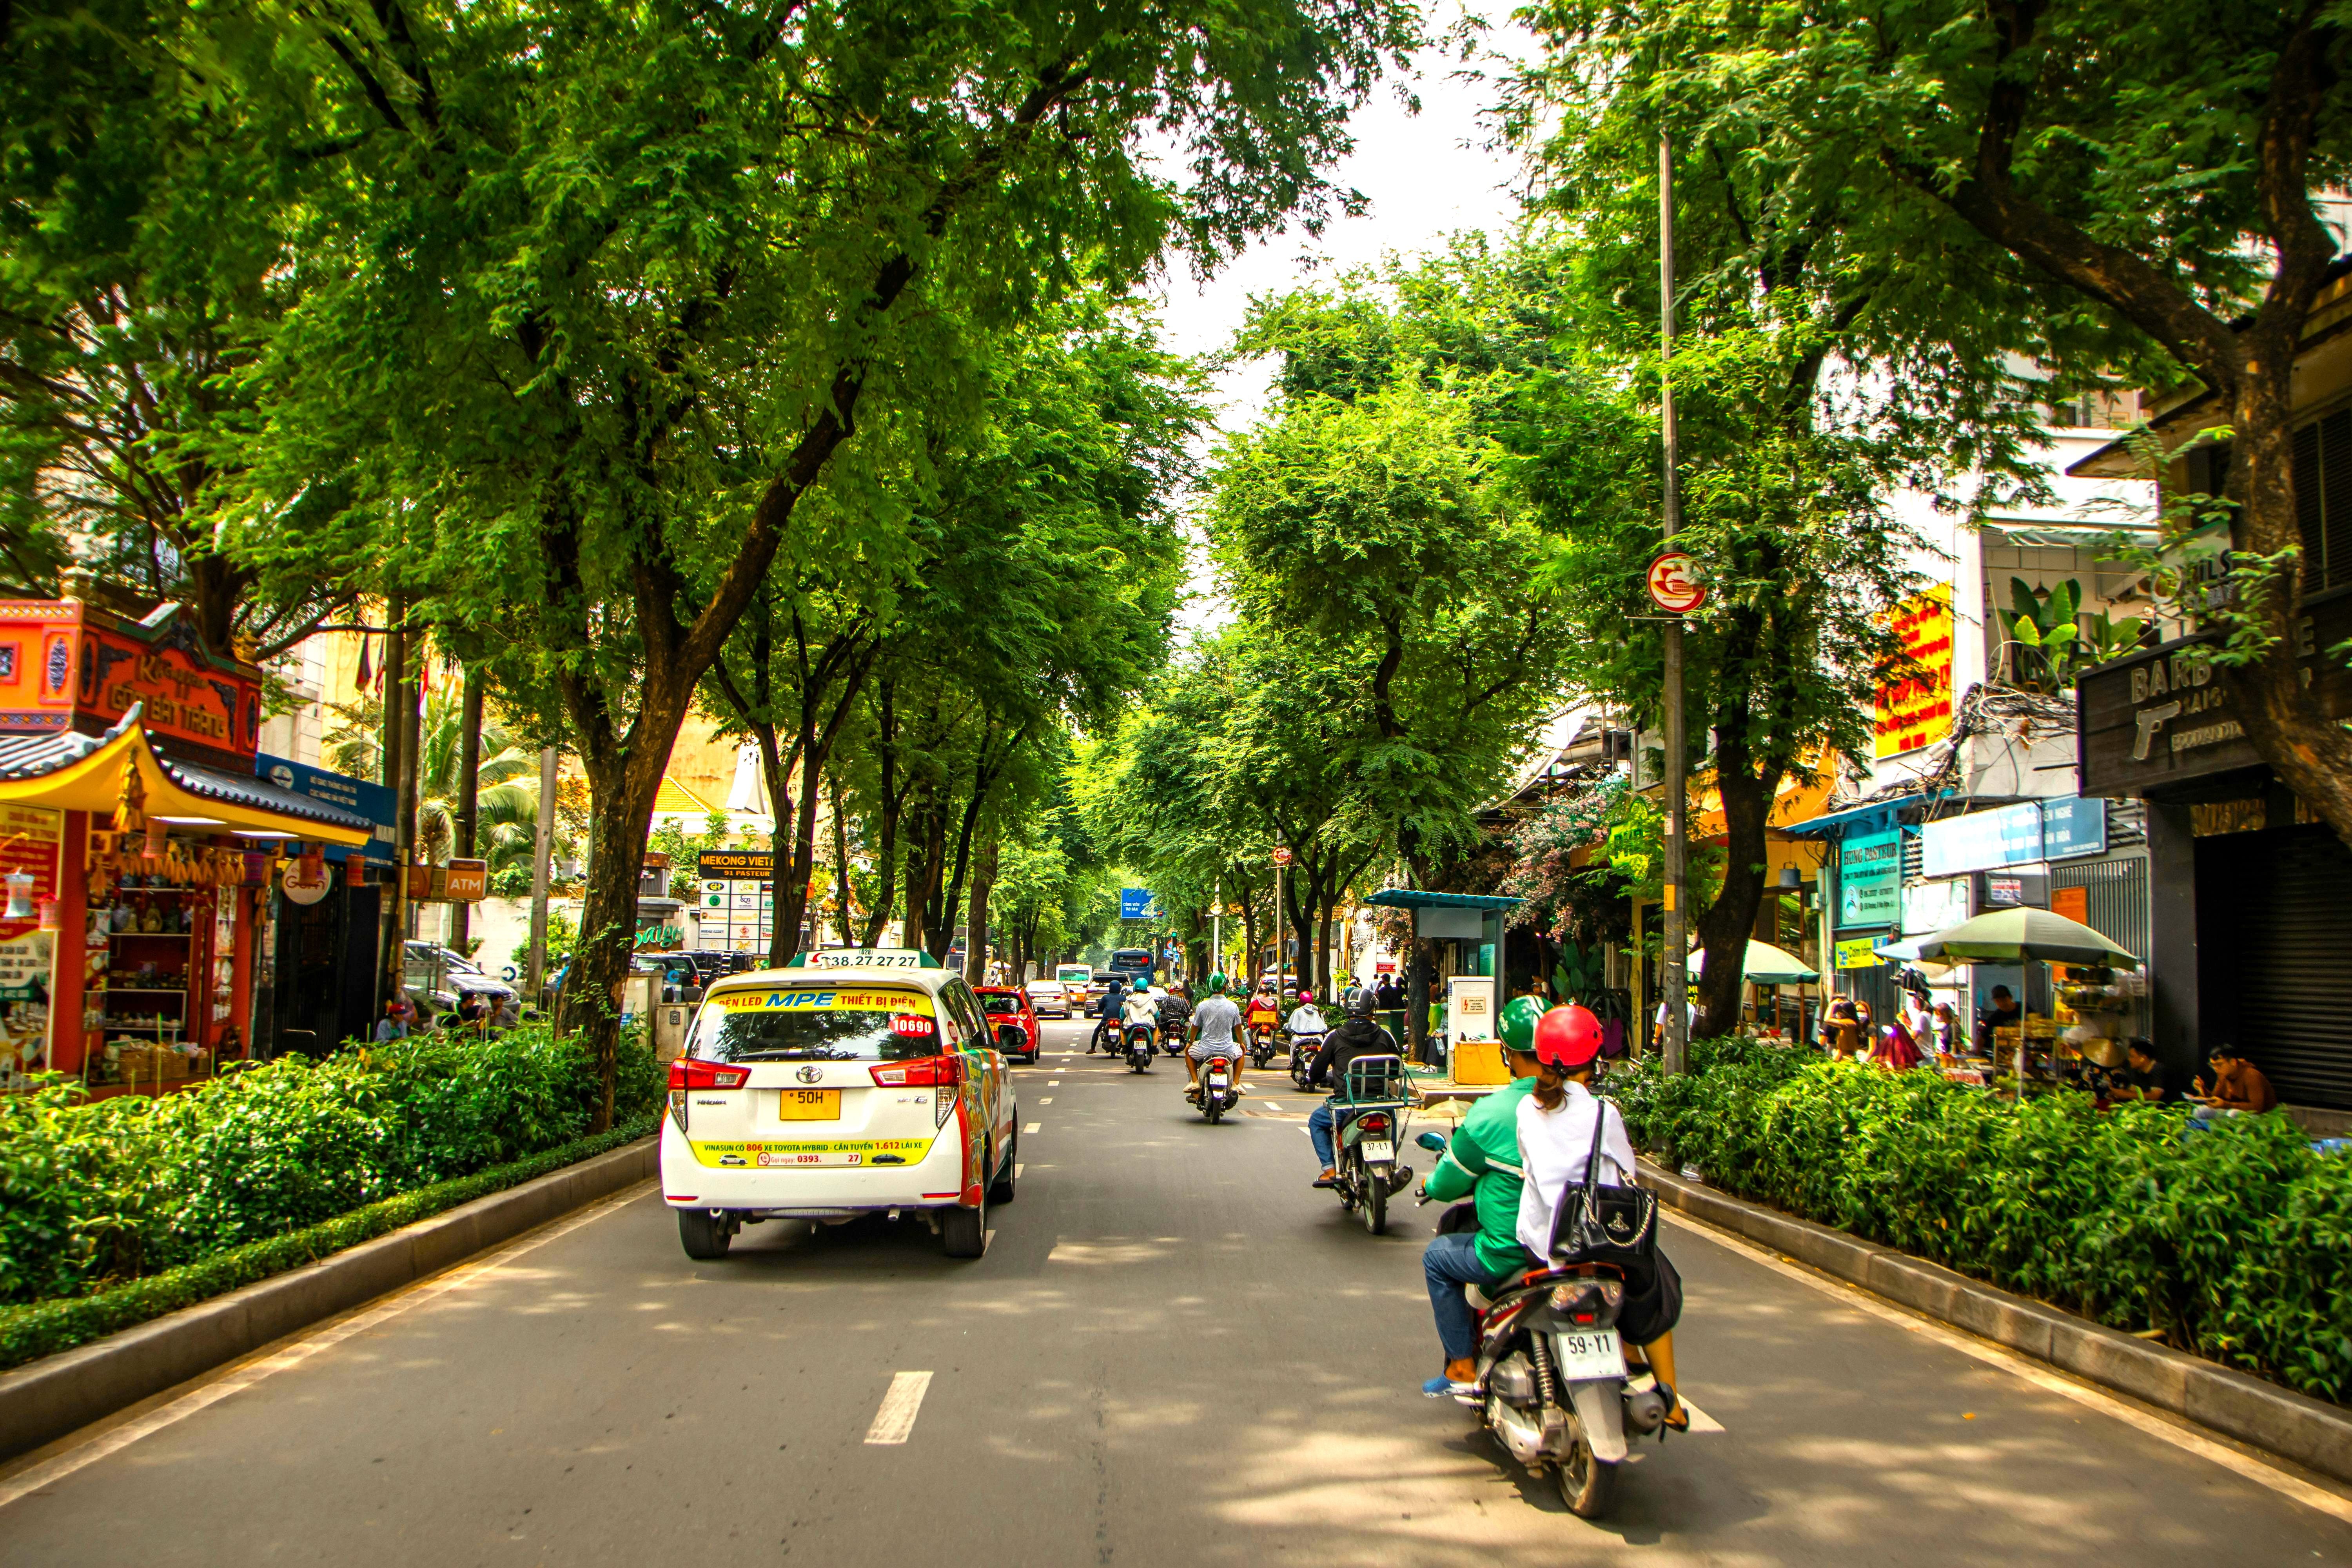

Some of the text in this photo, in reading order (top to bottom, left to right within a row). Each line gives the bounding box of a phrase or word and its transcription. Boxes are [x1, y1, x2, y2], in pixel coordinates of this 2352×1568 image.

[701, 856, 746, 866] MEKONG
[450, 878, 481, 891] ATM
[877, 956, 894, 966] 27
[898, 957, 916, 967] 27
[742, 996, 762, 1006] LED
[765, 993, 837, 1007] MPE
[841, 993, 872, 1005] THIẾT
[876, 996, 887, 1009] BỊ
[890, 996, 916, 1009] ĐIỆN
[893, 1020, 932, 1032] 10690
[798, 1091, 823, 1104] 50H
[875, 1142, 900, 1150] 1.612
[1367, 1142, 1388, 1151] 37-L1
[797, 1155, 822, 1163] 0393.
[1568, 1334, 1611, 1354] 59-Y1
